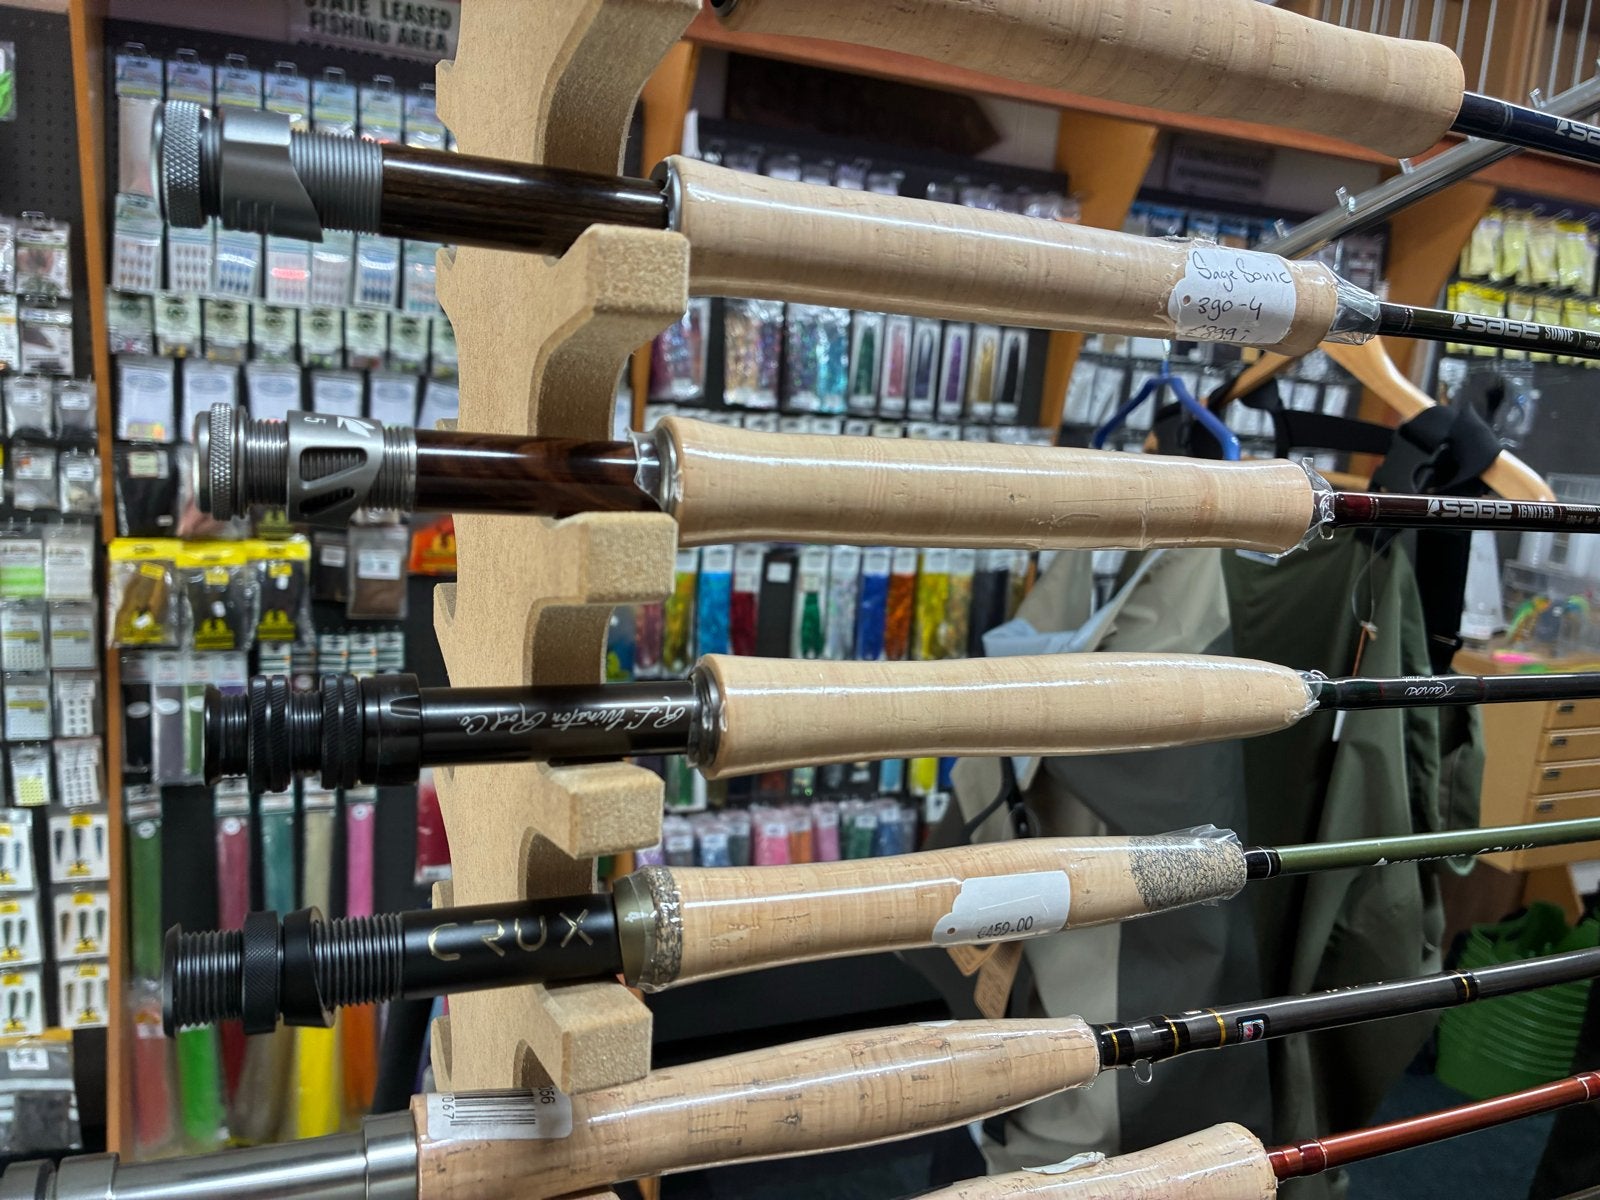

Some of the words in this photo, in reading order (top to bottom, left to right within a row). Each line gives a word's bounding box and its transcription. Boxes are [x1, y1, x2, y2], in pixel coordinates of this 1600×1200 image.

[310, 11, 391, 43] FISHING
[398, 26, 448, 50] AREA
[381, 1, 452, 31] LEASED
[1193, 251, 1238, 292] Sage
[1236, 258, 1293, 284] Sonic
[1198, 296, 1263, 321] 390-4
[1544, 326, 1575, 343] SONIC
[1518, 504, 1555, 519] IGNITER
[490, 702, 547, 734] Rod
[552, 707, 626, 732] Winston
[427, 908, 594, 962] CRUX
